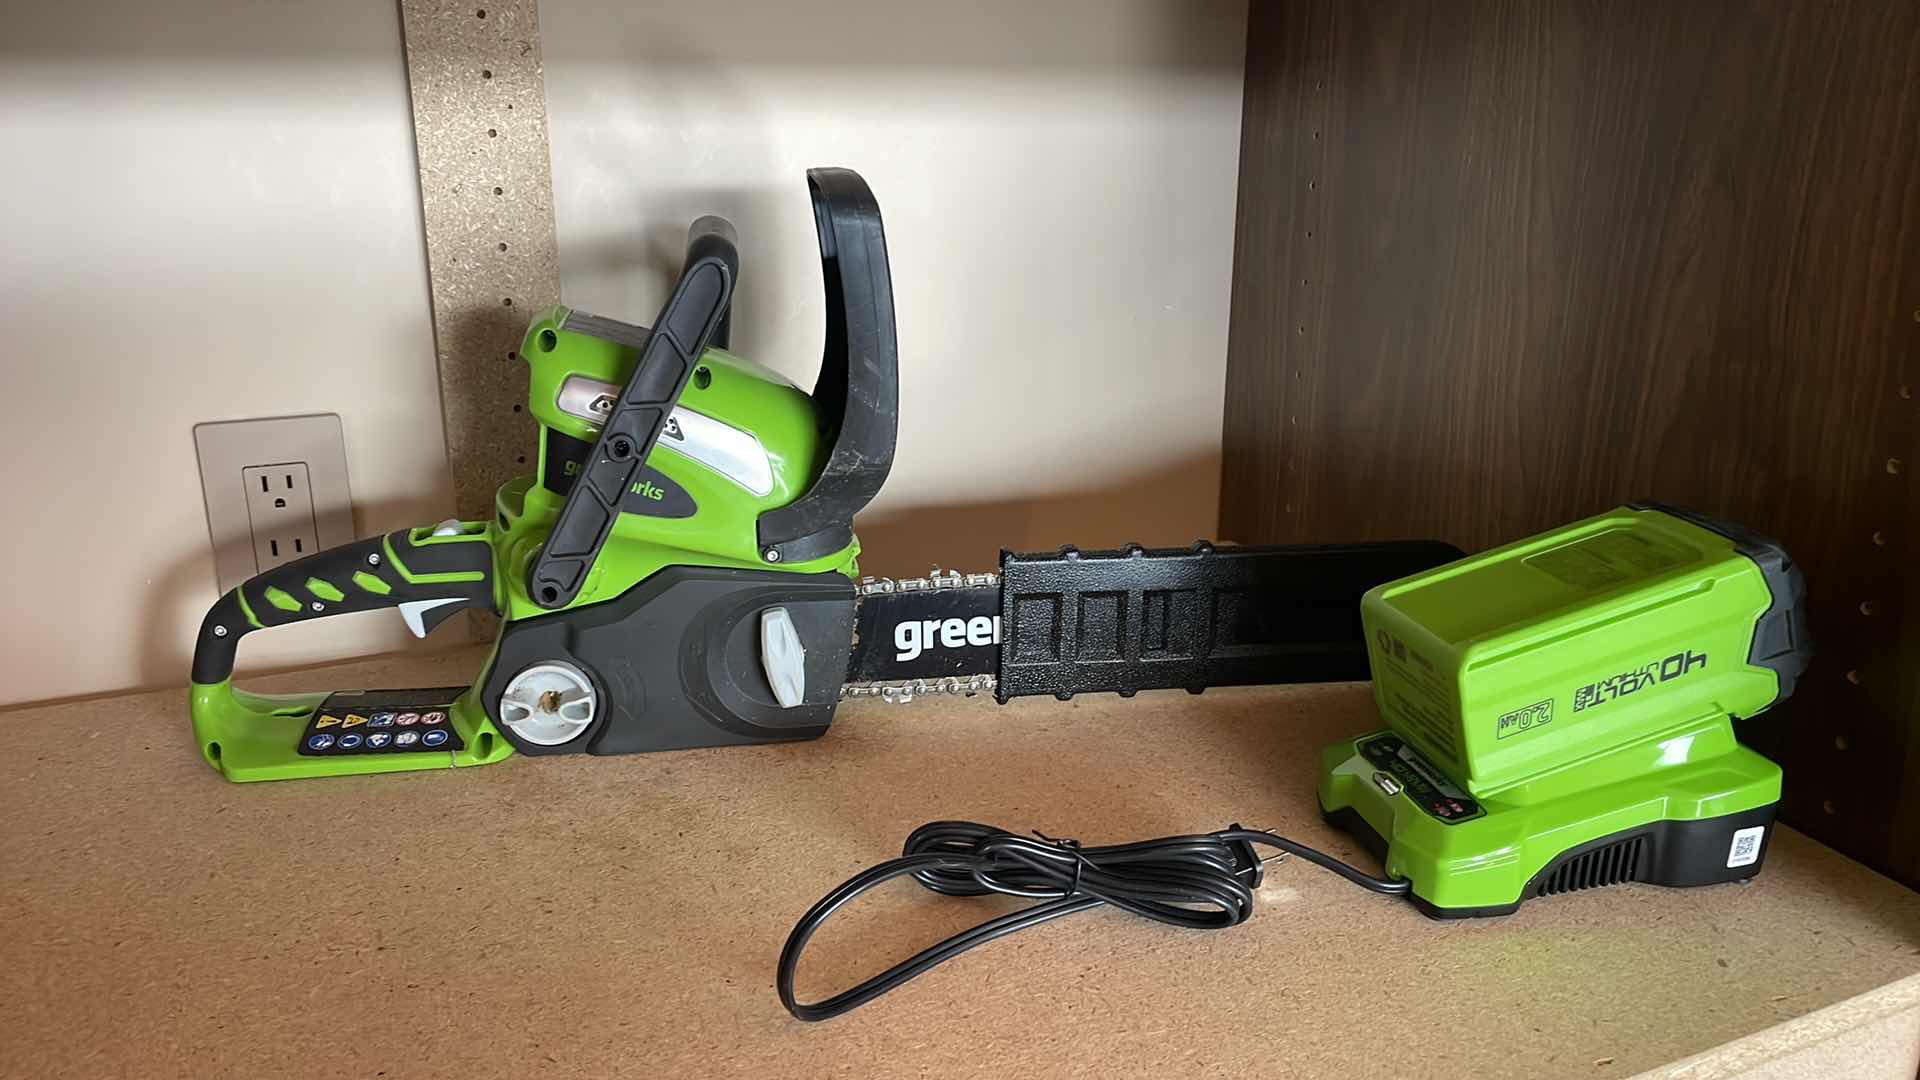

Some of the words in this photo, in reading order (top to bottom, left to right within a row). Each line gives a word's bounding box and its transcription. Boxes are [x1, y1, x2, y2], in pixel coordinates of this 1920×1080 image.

[1597, 662, 1659, 690] LITHIUM
[1660, 650, 1707, 682] 40
[1587, 673, 1655, 708] VOLT
